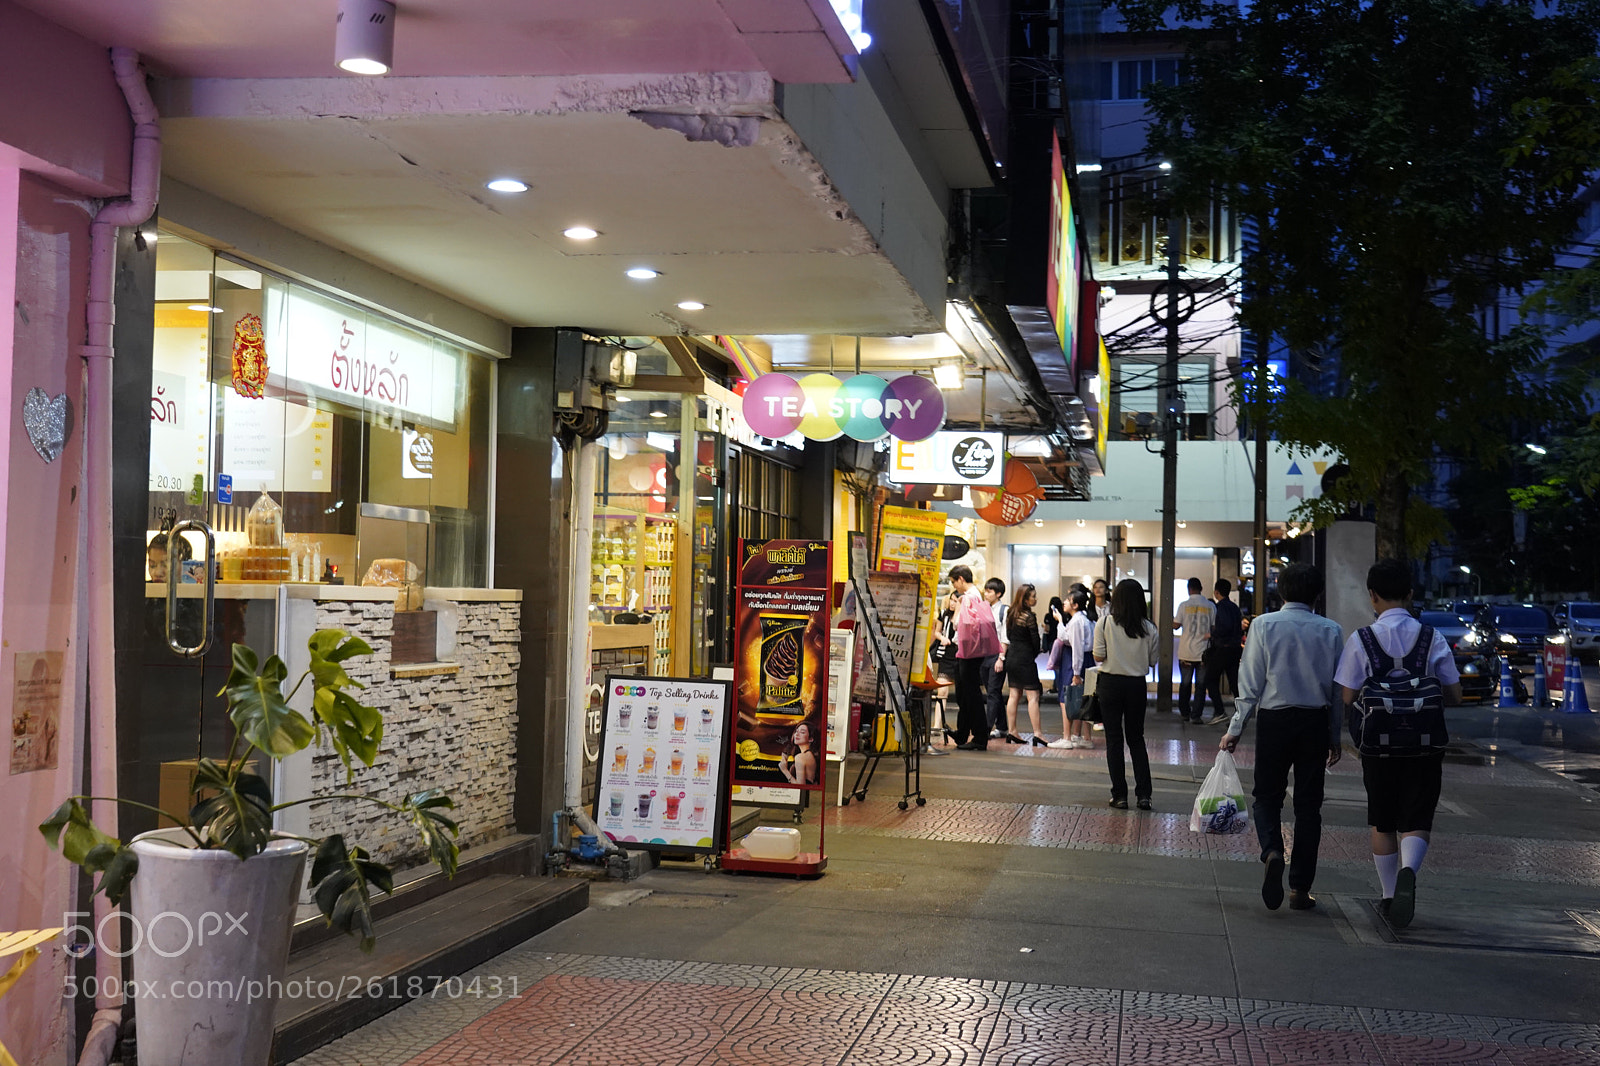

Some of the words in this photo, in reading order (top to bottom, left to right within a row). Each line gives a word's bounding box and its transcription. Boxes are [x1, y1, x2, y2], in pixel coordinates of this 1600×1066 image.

[331, 319, 409, 407] ตั้งหลัก
[763, 396, 819, 418] TEA
[828, 398, 923, 420] STORY
[157, 474, 182, 490] 20.30
[649, 687, 663, 700] Top
[664, 687, 692, 703] Selling
[693, 689, 720, 700] Drinks
[587, 710, 601, 735] TE
